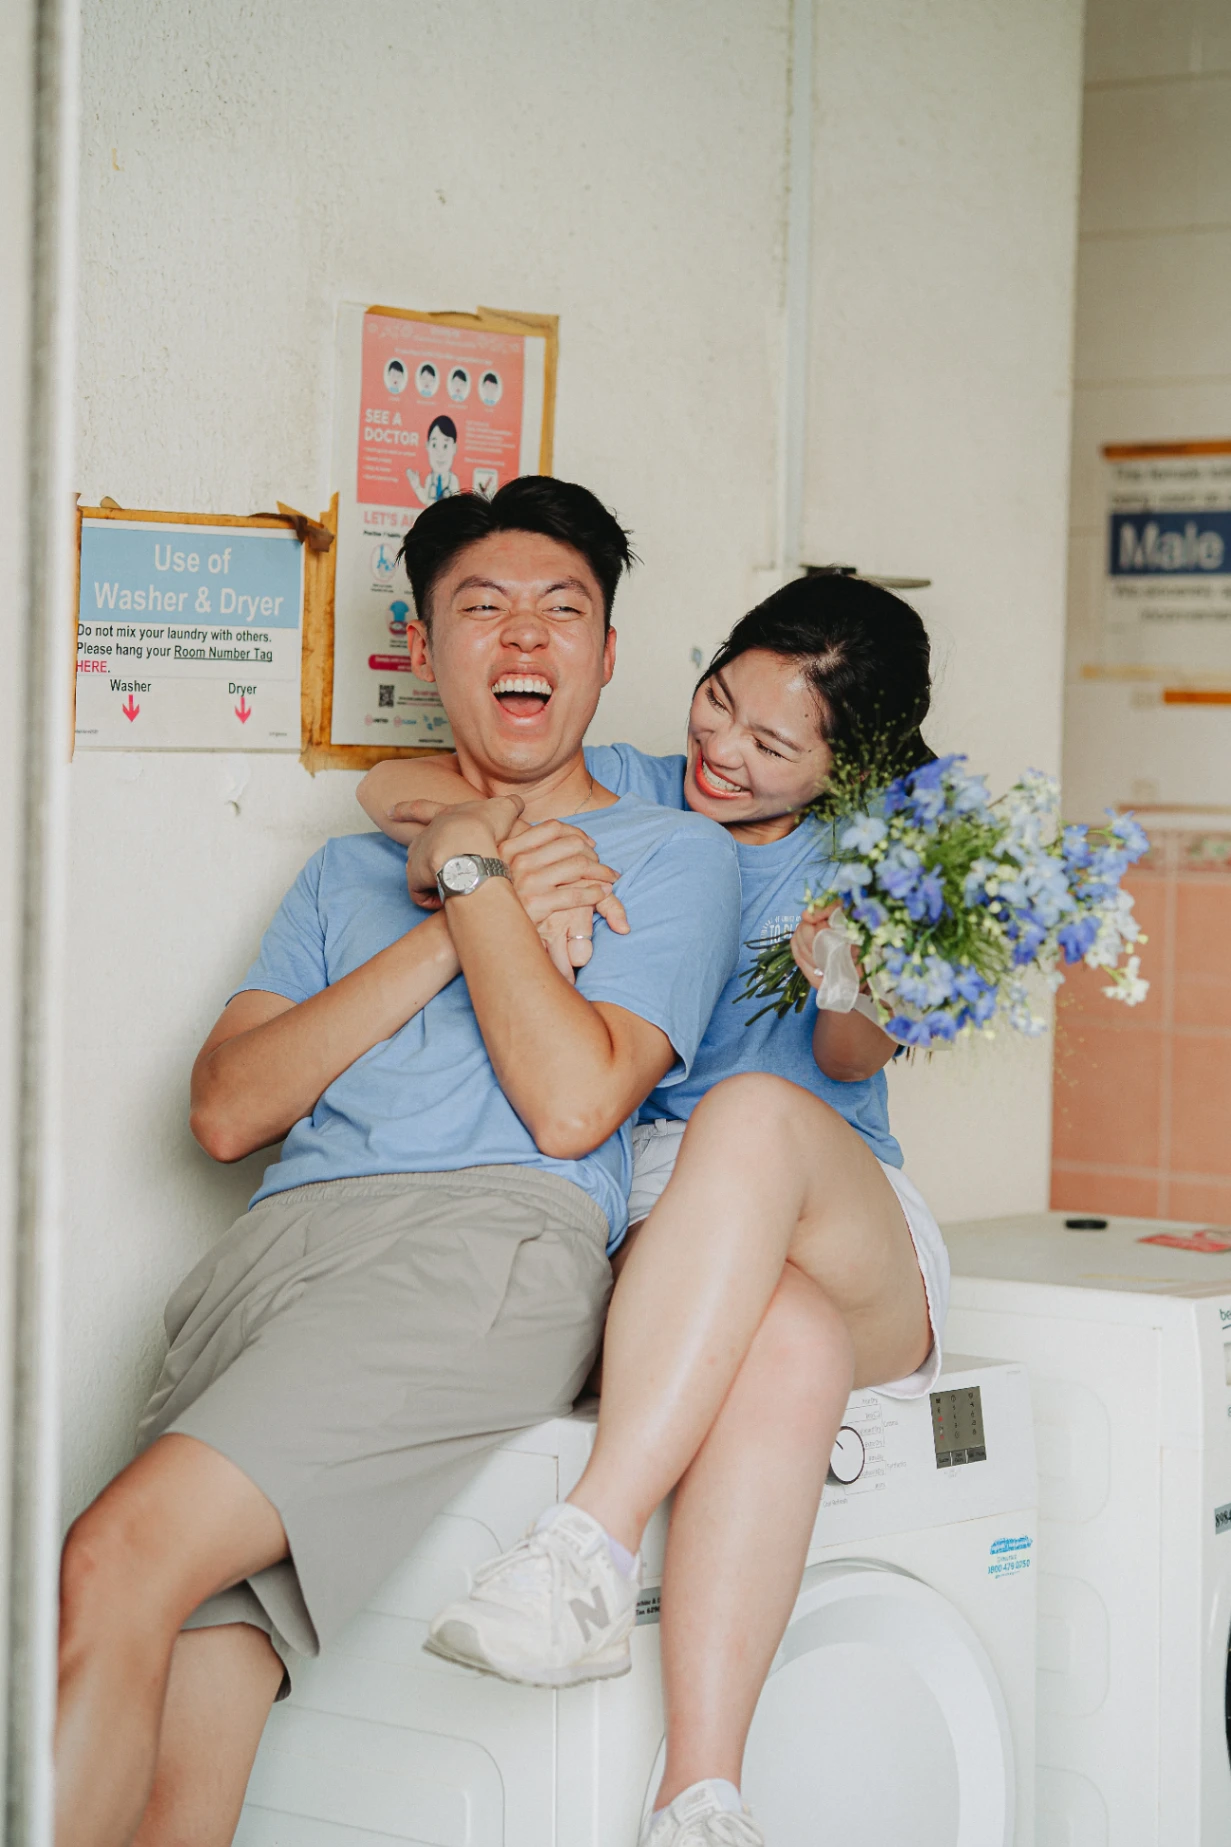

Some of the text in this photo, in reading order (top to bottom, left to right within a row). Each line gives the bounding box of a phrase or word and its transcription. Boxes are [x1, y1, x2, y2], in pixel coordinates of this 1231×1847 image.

[365, 408, 403, 427] SEE A
[364, 426, 419, 446] DOCTOR
[364, 511, 397, 526] LET'S
[1119, 520, 1225, 571] Male
[154, 543, 232, 574] Use of
[94, 581, 285, 622] Washer & Dryer
[77, 623, 272, 643] Do not mix your laundry with others.
[77, 641, 273, 662] Please hang your Room Number Tag
[110, 679, 257, 697] Washer Dryer
